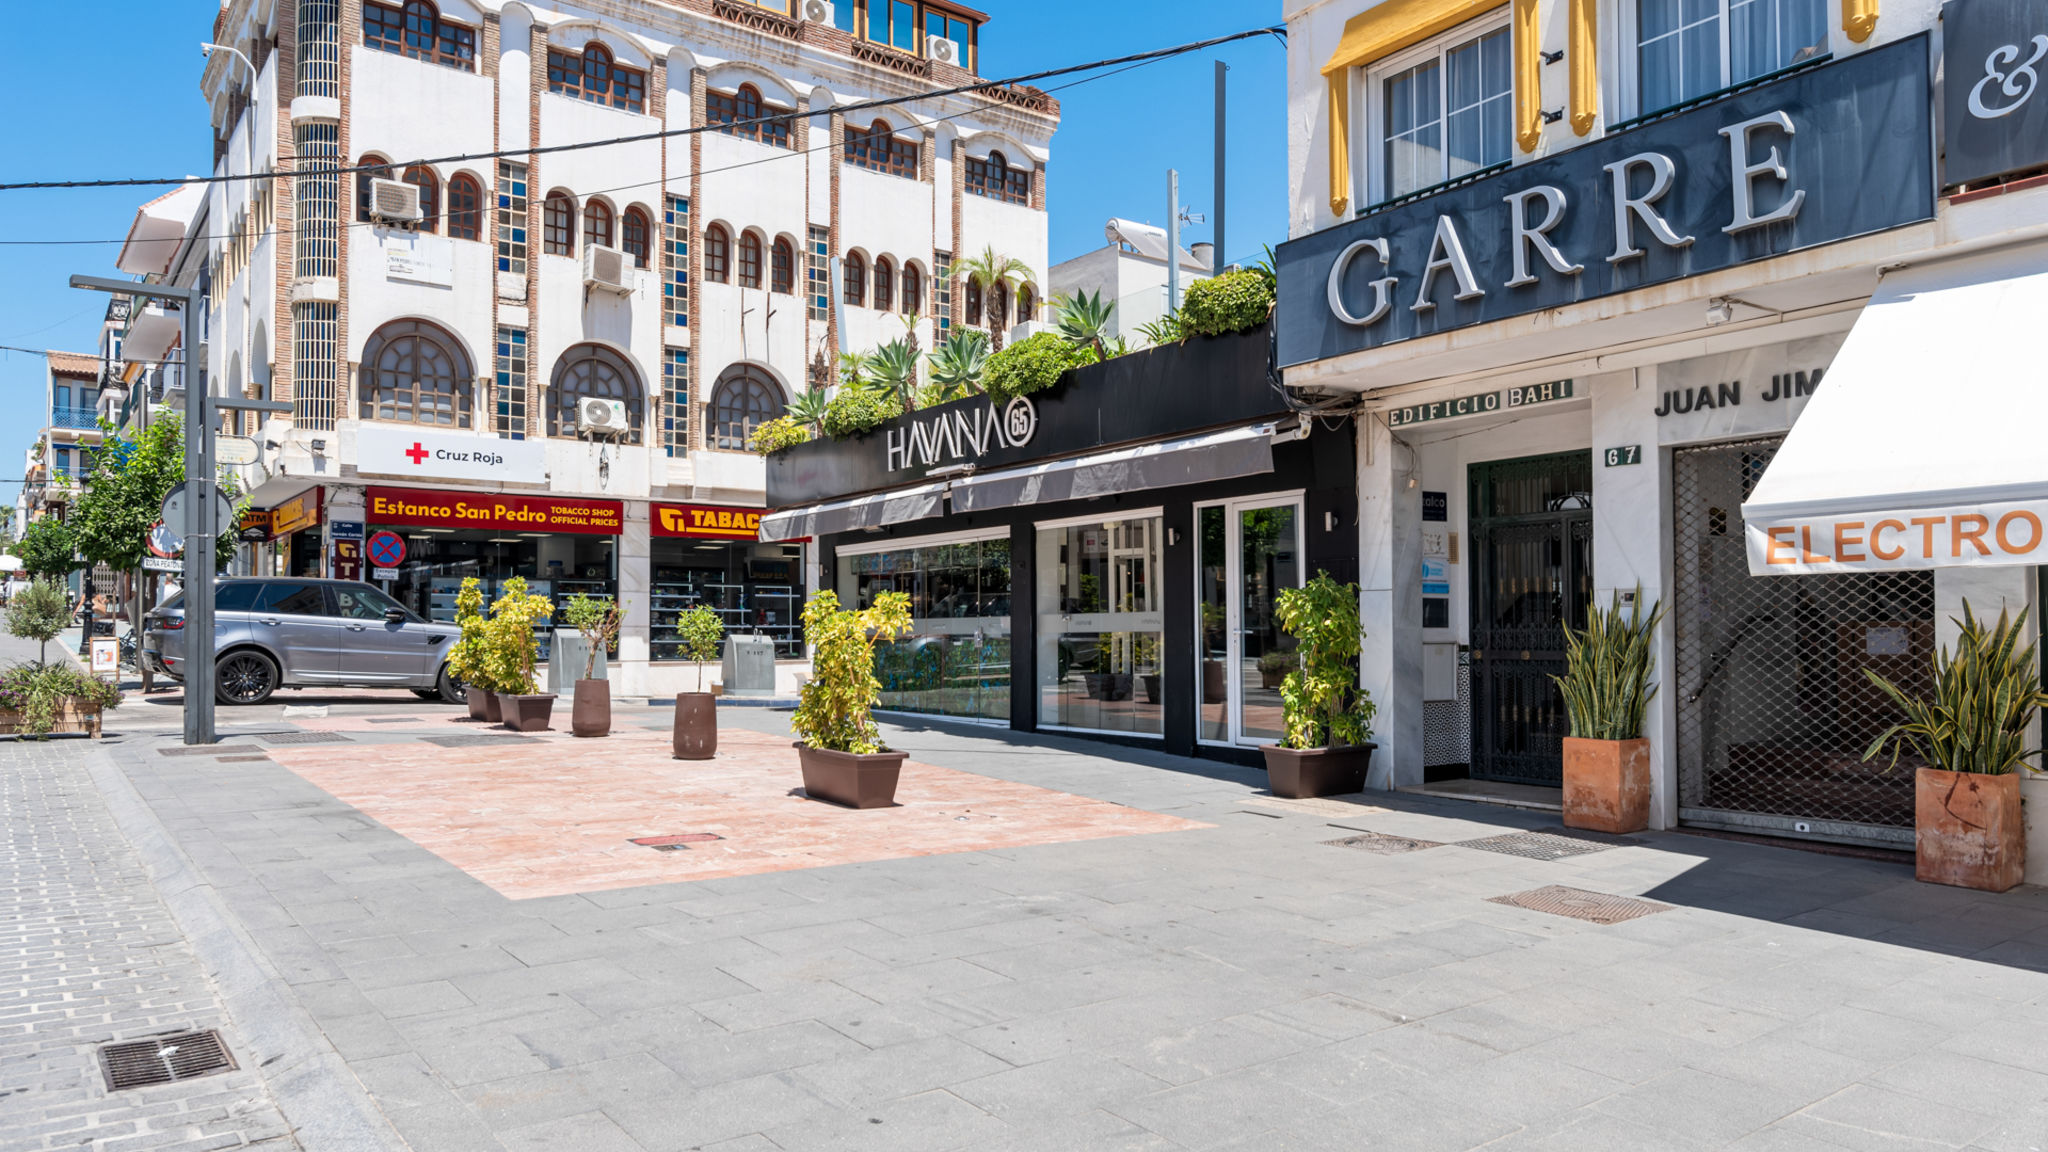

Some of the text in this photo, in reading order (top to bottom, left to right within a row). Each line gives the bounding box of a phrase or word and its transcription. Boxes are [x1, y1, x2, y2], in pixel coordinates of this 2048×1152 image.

[1327, 109, 1806, 326] GARRE
[1390, 381, 1566, 426] EDIFICIO BAHI
[1654, 381, 1741, 417] JUAN
[1010, 406, 1029, 436] 65
[887, 401, 1008, 472] HAVANA
[436, 449, 503, 466] Cruz Roja
[373, 497, 547, 523] Estanco San Pedro
[550, 506, 615, 517] TOBACCO SHOP
[550, 516, 619, 527] OFFICIAL PRICES
[691, 510, 767, 530] TABAC
[1765, 510, 2043, 565] ELECTRO
